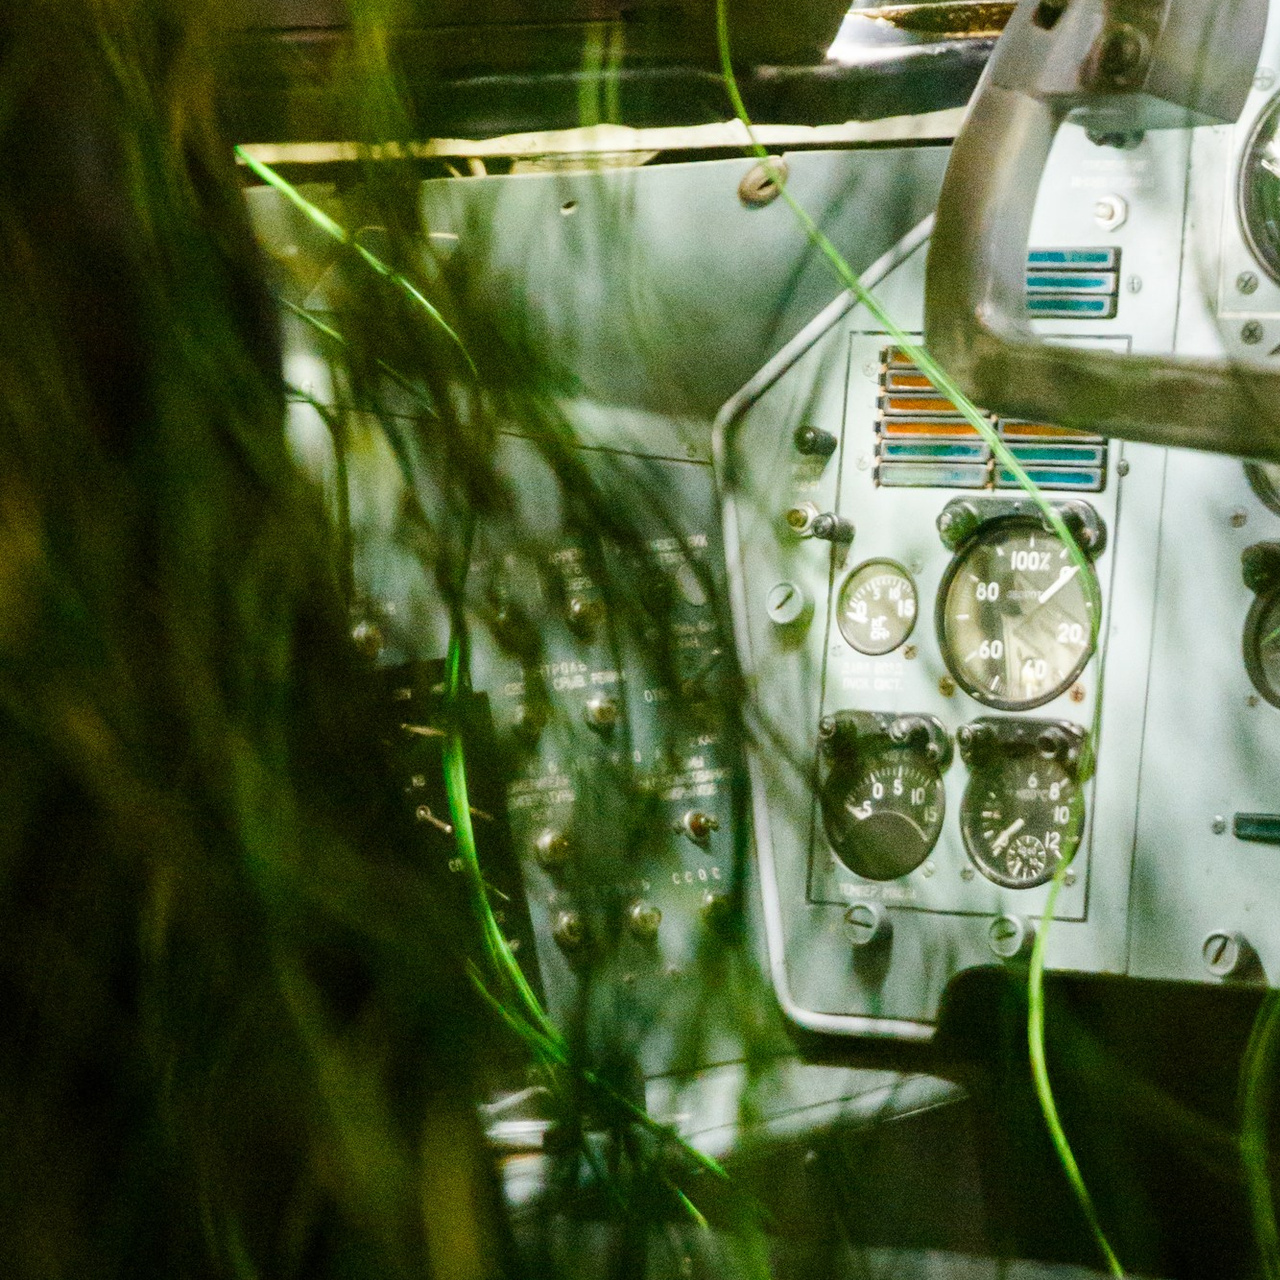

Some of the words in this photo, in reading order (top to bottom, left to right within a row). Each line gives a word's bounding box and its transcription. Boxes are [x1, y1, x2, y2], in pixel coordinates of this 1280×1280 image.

[1010, 550, 1051, 571] 100%
[873, 587, 880, 600] 5
[889, 587, 901, 600] 10
[976, 582, 999, 601] 80
[897, 598, 915, 618] 15
[1057, 623, 1082, 644] 20
[979, 639, 1003, 659] 60
[1022, 659, 1047, 680] 40
[893, 778, 903, 796] 5
[1028, 772, 1038, 789] 6
[872, 782, 883, 800] 0
[911, 787, 925, 805] 10
[1049, 781, 1060, 801] 8
[924, 806, 937, 823] 15
[1053, 805, 1070, 825] 10
[1045, 831, 1060, 849] 12
